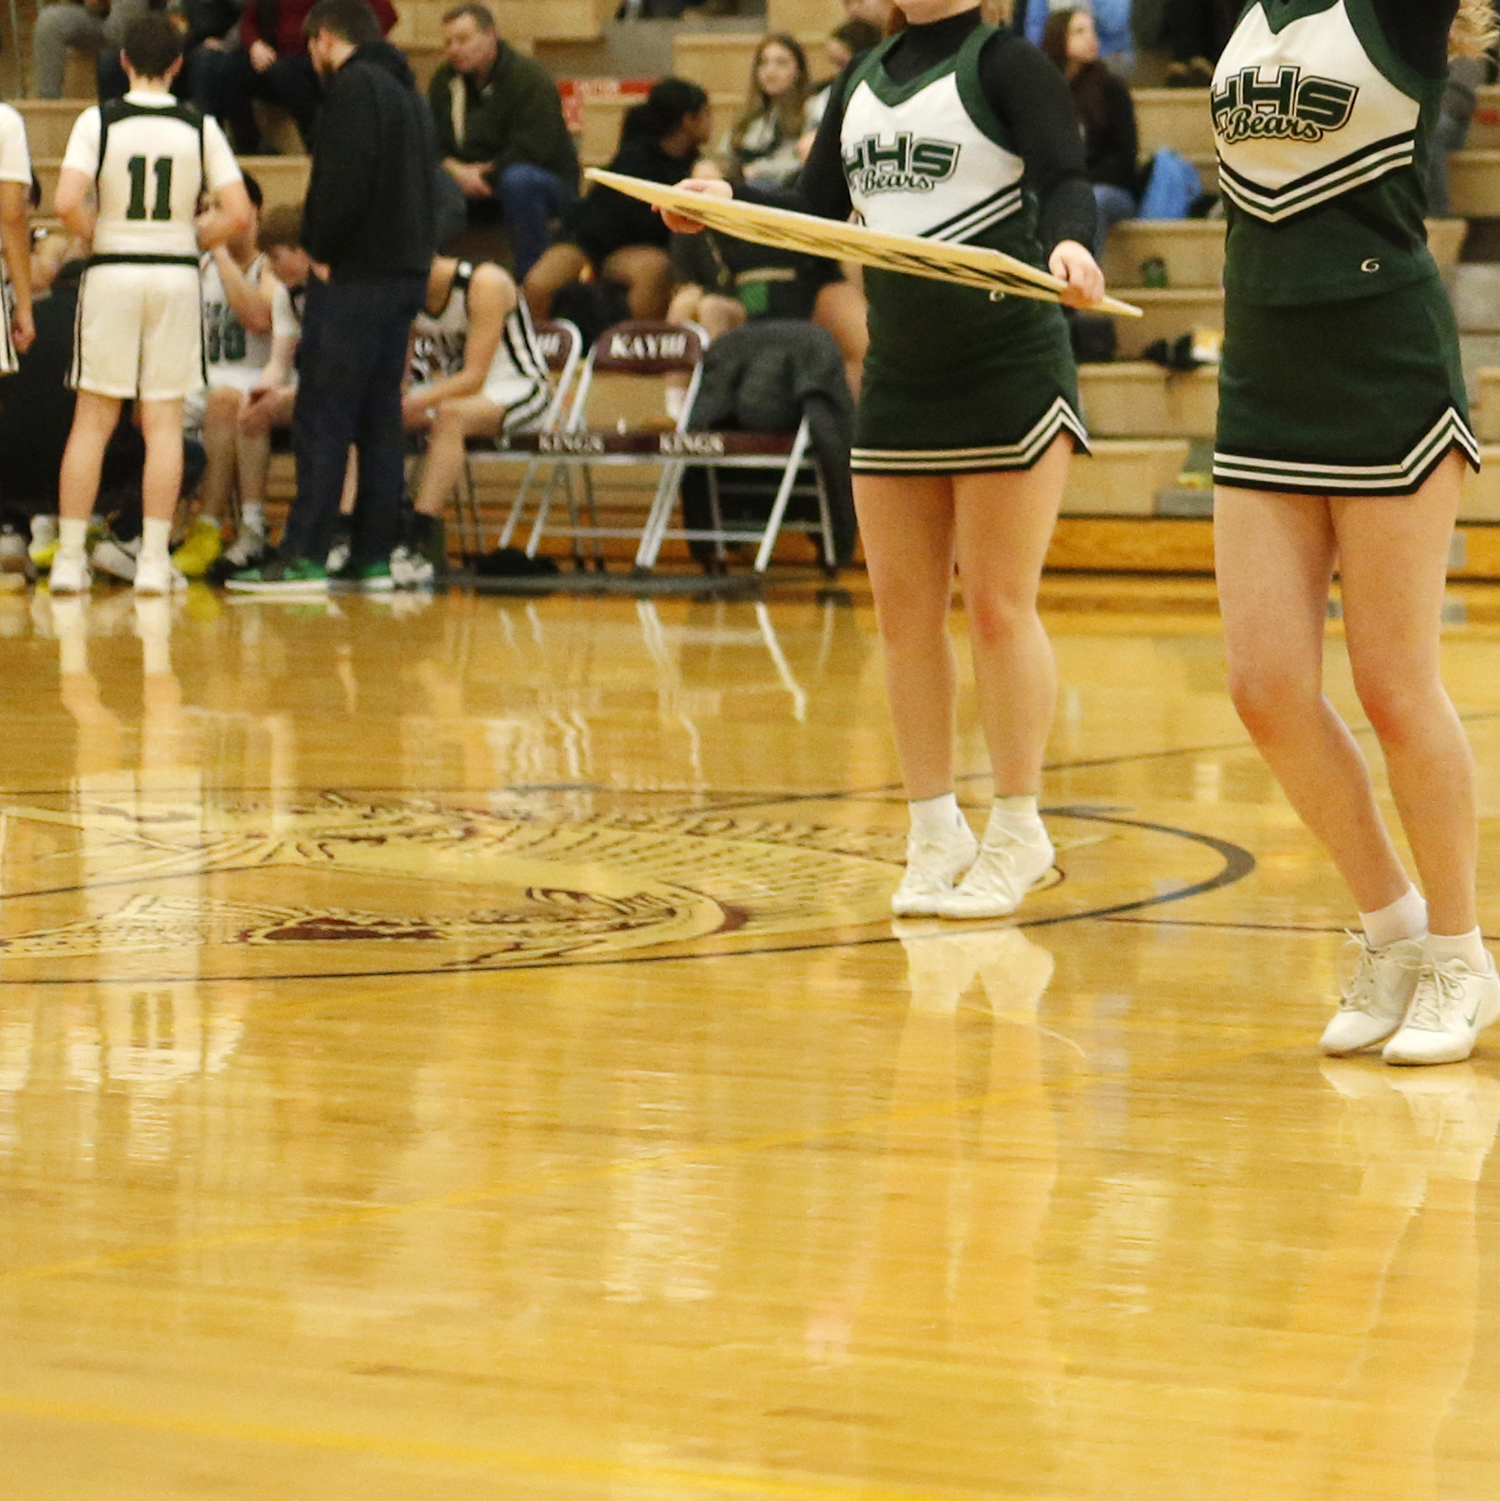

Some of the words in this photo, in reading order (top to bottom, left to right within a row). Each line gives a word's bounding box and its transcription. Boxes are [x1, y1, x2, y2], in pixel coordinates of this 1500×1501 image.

[1211, 65, 1360, 134] HHS
[1225, 103, 1324, 143] Bears
[125, 155, 173, 221] 11
[861, 168, 936, 197] Bears
